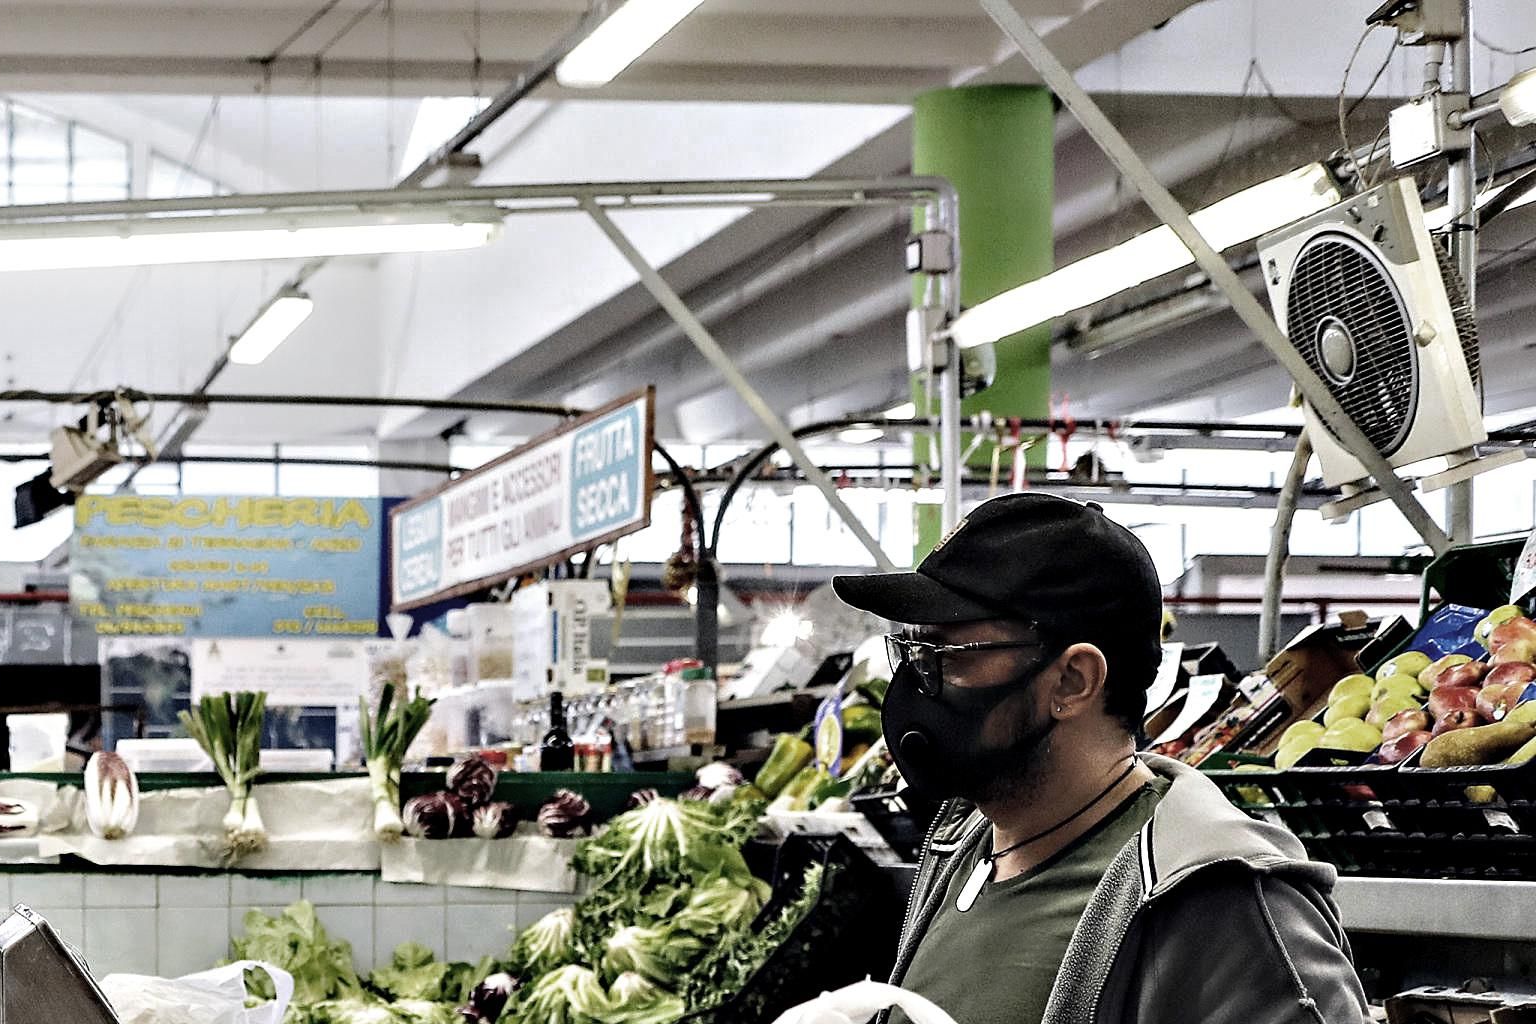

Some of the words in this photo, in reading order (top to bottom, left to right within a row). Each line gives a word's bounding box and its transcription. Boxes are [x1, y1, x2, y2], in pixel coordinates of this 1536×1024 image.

[575, 415, 634, 478] FRUTTA
[74, 495, 373, 529] PESCHERIA
[576, 470, 630, 528] SECCA
